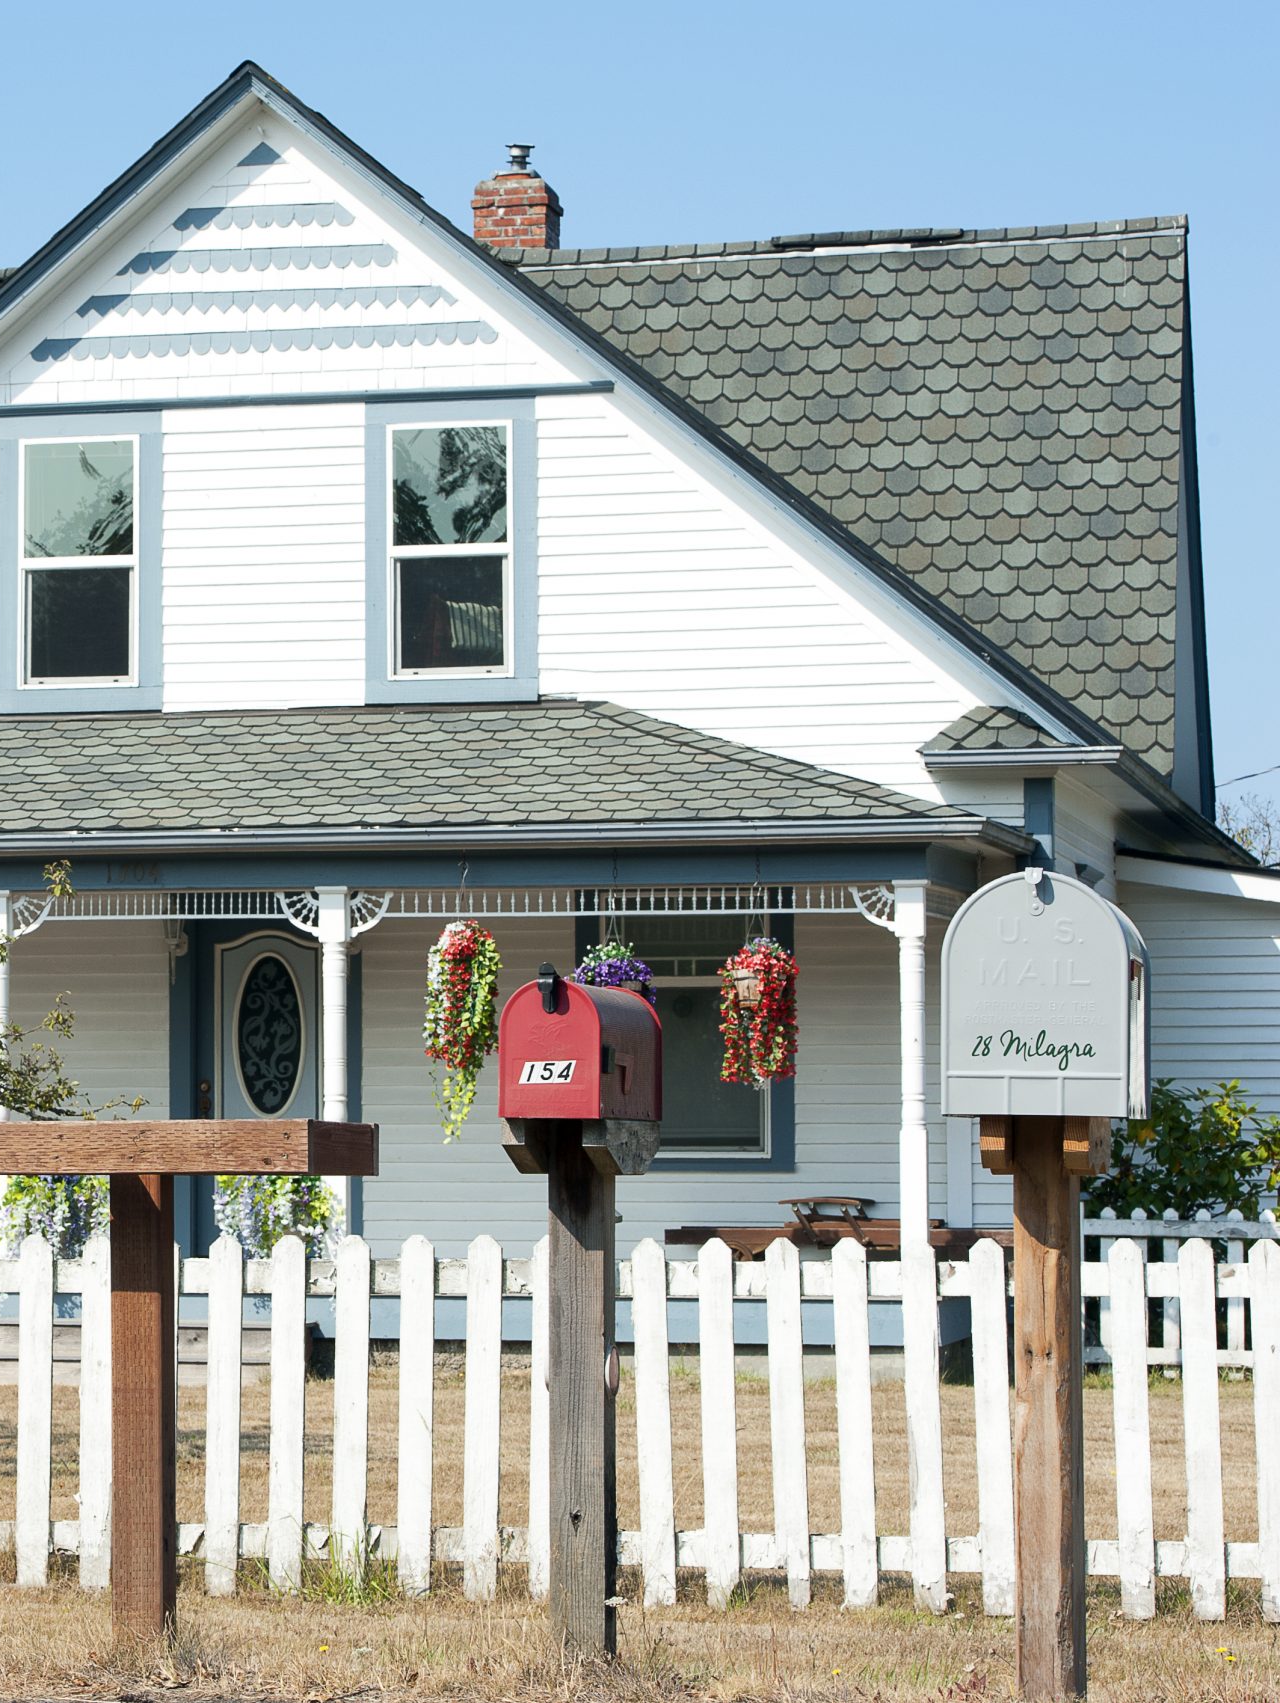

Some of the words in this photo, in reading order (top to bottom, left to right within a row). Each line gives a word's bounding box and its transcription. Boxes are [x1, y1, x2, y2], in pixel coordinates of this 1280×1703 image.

[979, 958, 1091, 987] MAIL
[971, 1035, 993, 1057] 28
[999, 1029, 1096, 1072] Milagra
[526, 1062, 573, 1082] 154
